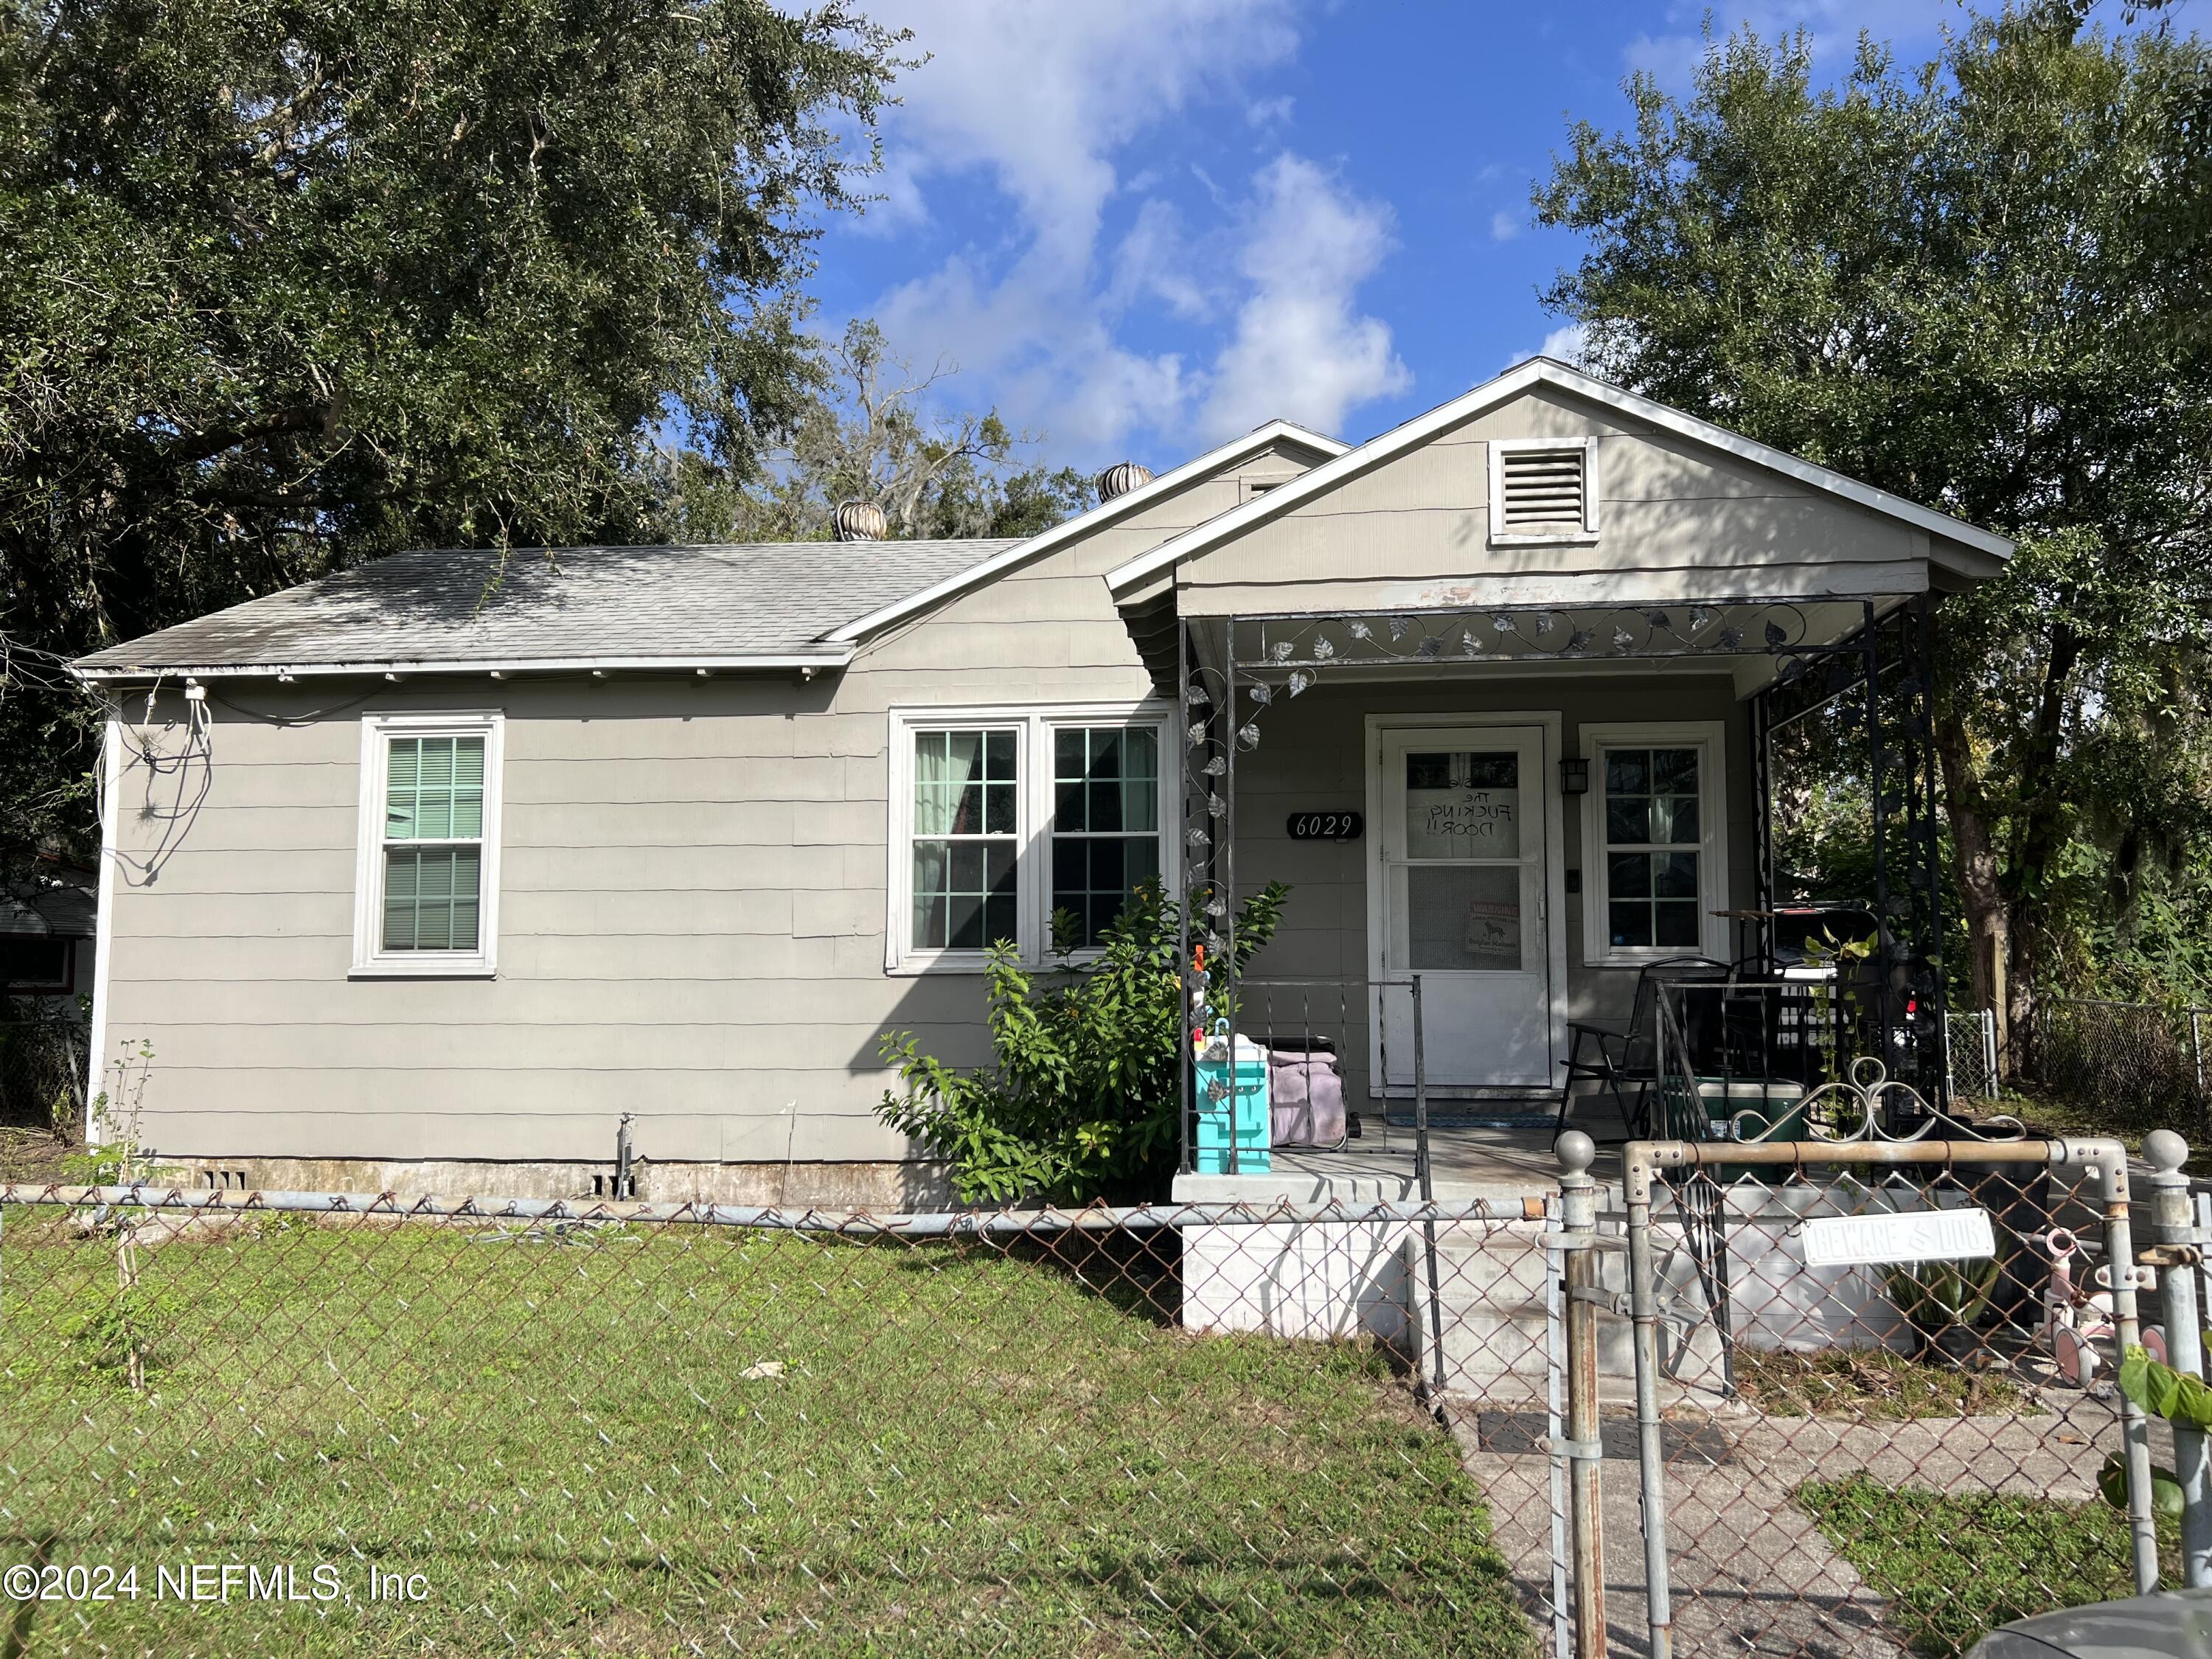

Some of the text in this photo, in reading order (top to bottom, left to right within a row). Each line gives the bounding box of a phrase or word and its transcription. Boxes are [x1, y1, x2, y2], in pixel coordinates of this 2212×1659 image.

[1296, 815, 1352, 835] 6029
[1812, 1220, 1902, 1259] BEWARE
[1937, 1217, 1981, 1252] DOG
